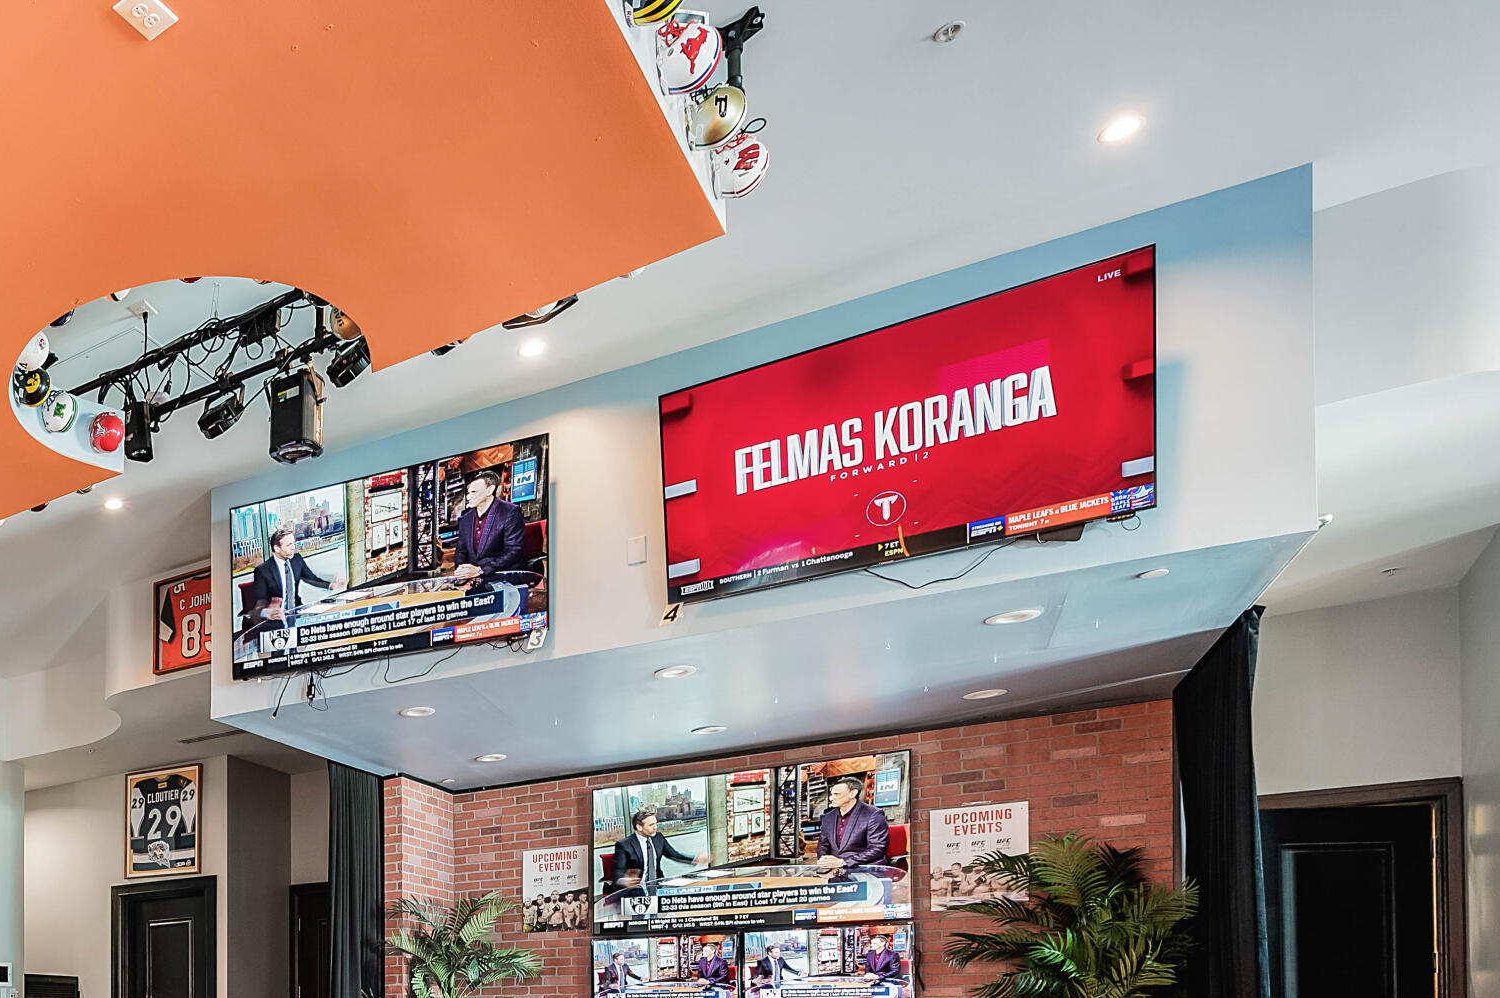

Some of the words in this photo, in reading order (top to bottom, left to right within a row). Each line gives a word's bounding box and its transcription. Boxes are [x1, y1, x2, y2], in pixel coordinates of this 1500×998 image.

[1097, 269, 1121, 282] LIVE
[734, 416, 864, 496] FELMAS
[874, 365, 1058, 461] KORANGA
[830, 456, 908, 483] FORWARD
[516, 475, 532, 484] IN
[1008, 512, 1031, 524] MAPLE
[1033, 508, 1054, 519] LEAFS
[1061, 502, 1078, 513] BLUE
[1079, 496, 1109, 509] JACKETS
[1009, 520, 1038, 532] TONIGHT
[719, 572, 753, 585] SOUTHERN
[762, 564, 789, 576] Furman
[806, 550, 854, 566] Chattanooga
[300, 627, 310, 636] Do
[311, 624, 326, 635] Nets
[327, 622, 343, 632] have
[344, 618, 369, 631] enough
[370, 612, 394, 624] around
[396, 608, 409, 619] star
[410, 605, 436, 621] players
[438, 605, 445, 613] to
[446, 603, 459, 611] win
[460, 599, 473, 609] the
[474, 595, 495, 607] East?
[663, 603, 680, 622] 4
[269, 628, 290, 639] NETS
[300, 635, 317, 644] 32-33
[317, 633, 328, 641] this
[329, 630, 351, 639] season
[392, 619, 407, 628] Lost
[446, 610, 468, 621] games
[530, 630, 543, 648] 3
[131, 797, 145, 809] 29
[147, 789, 180, 804] CLOUTIER
[182, 788, 195, 802] 29
[147, 805, 182, 841] 29
[944, 808, 1012, 825] UPCOMING
[954, 821, 1003, 836] EVENTS
[532, 850, 578, 863] UPCOMING
[538, 861, 572, 872] EVENTS
[629, 896, 651, 906] NETS
[661, 897, 670, 905] Do
[672, 896, 688, 904] Nets
[688, 895, 704, 903] have
[705, 893, 730, 902] enough
[732, 892, 756, 901] around
[757, 890, 771, 898] star
[772, 889, 798, 902] players
[799, 888, 807, 896] to
[808, 888, 822, 896] win
[823, 886, 835, 894] the
[836, 884, 858, 893] East?
